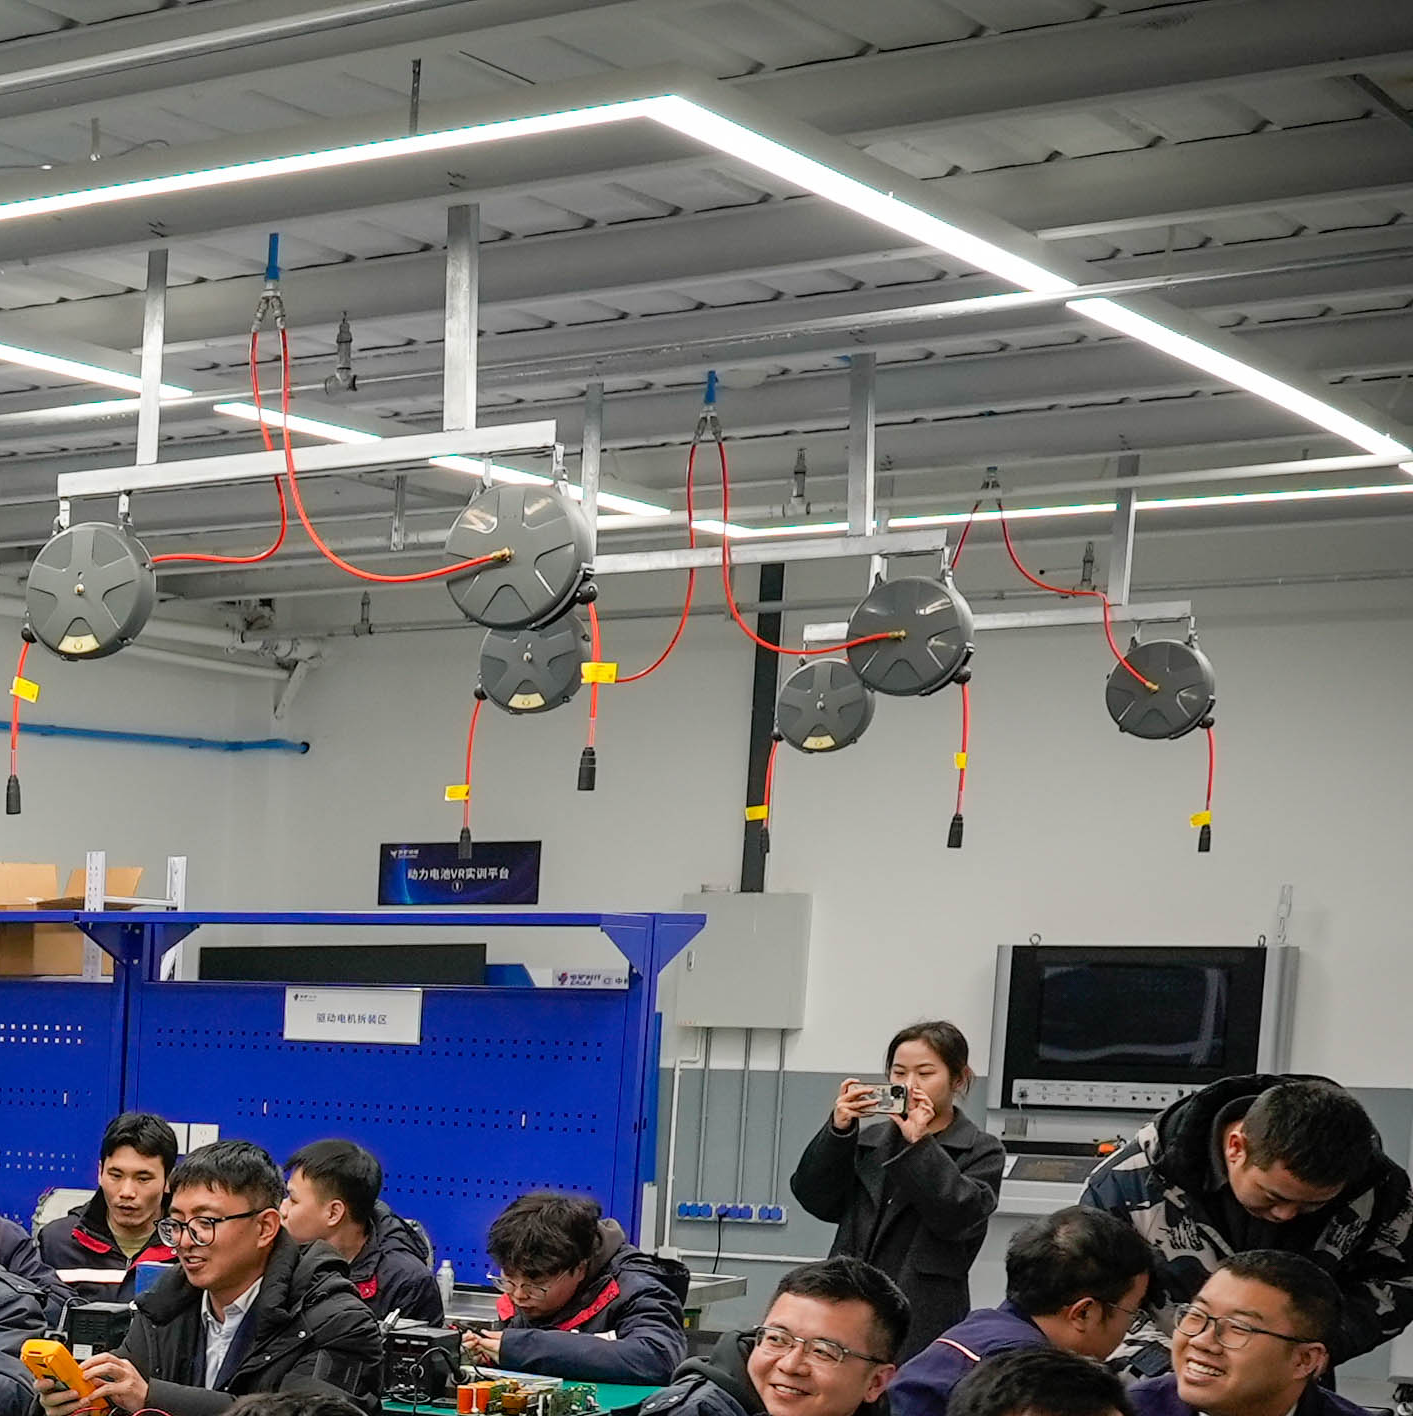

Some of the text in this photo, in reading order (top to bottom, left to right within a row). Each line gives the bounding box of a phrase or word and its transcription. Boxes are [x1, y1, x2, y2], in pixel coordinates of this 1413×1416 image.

[407, 866, 510, 881] 动力电池VR实训平台
[316, 1012, 388, 1025] 驱动电机拆装区
